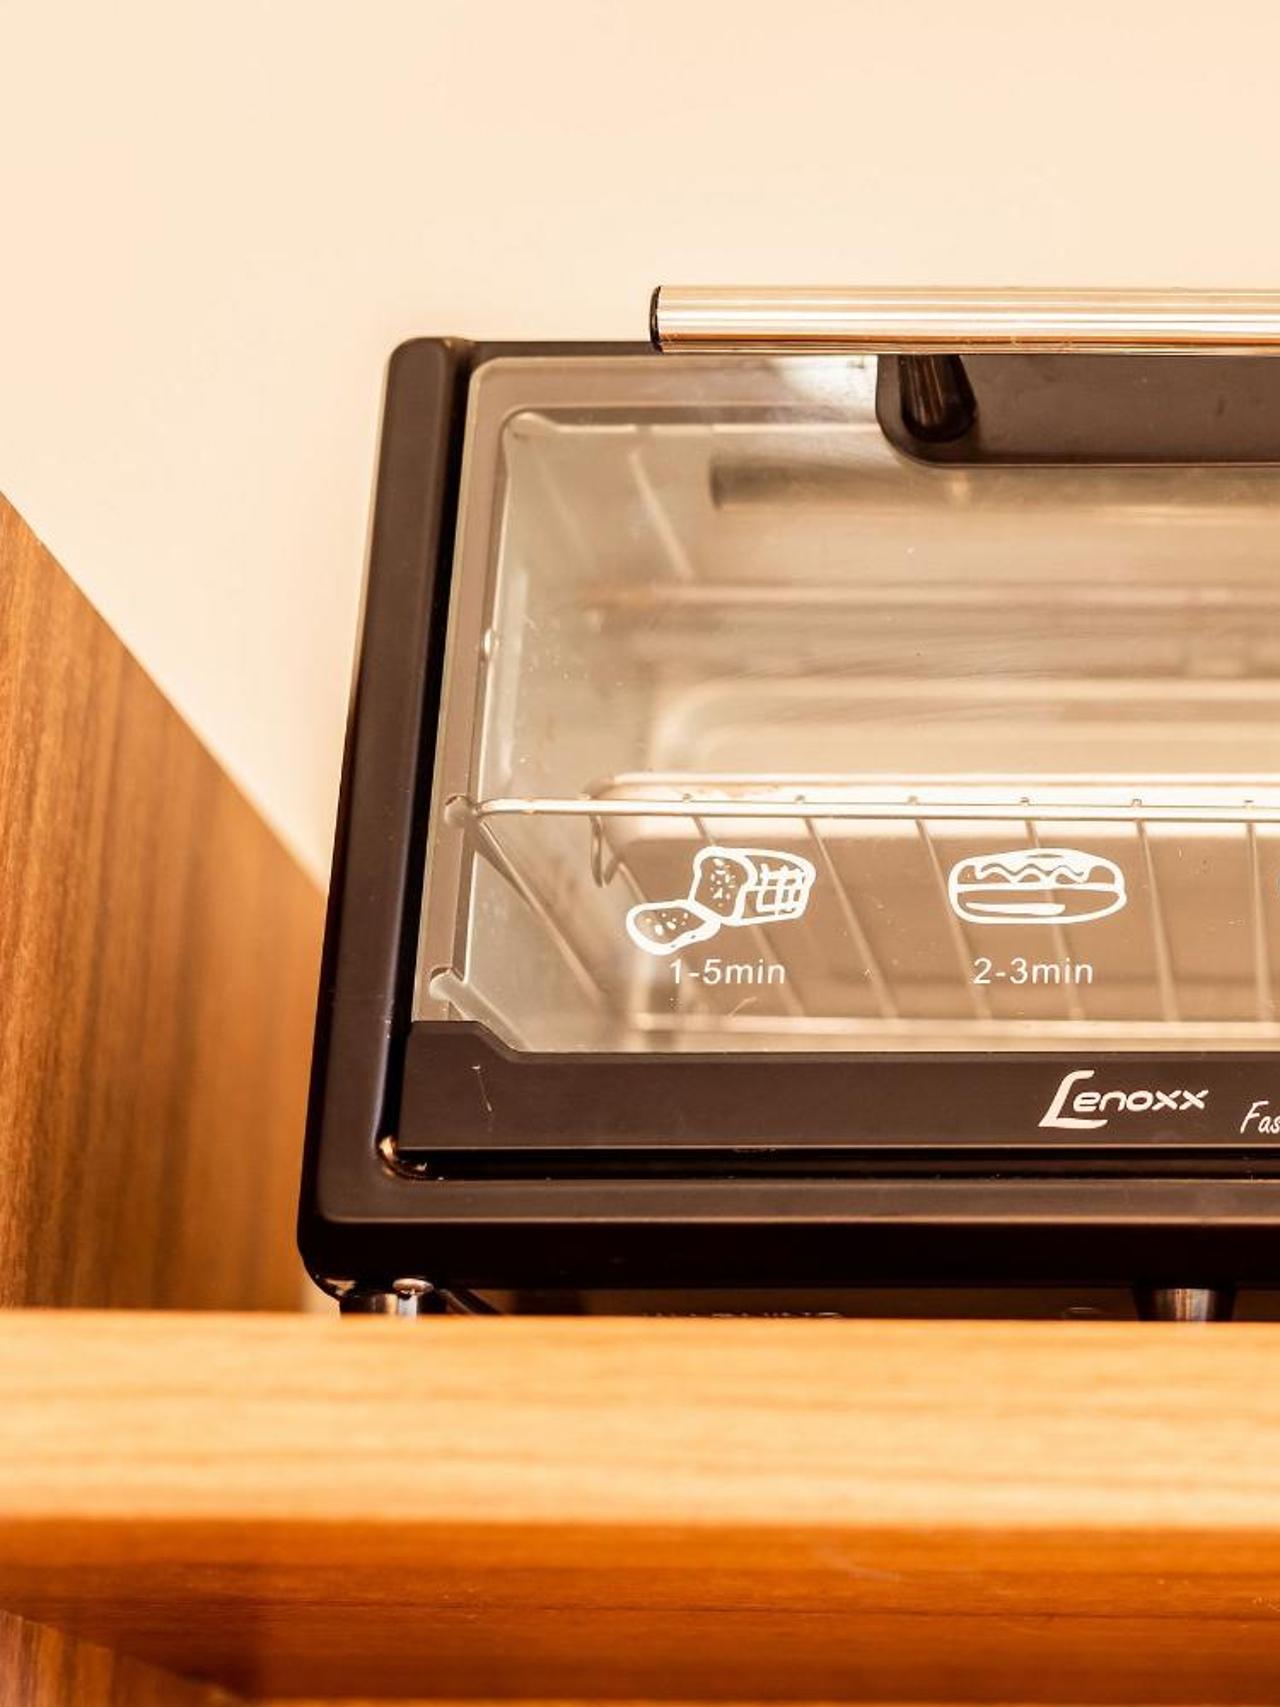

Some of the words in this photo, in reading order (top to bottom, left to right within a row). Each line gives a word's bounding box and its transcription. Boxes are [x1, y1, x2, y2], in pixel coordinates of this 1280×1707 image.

[668, 958, 786, 984] 1-5min
[972, 958, 1093, 984] 2-3min
[1038, 1069, 1209, 1129] Lenoxx
